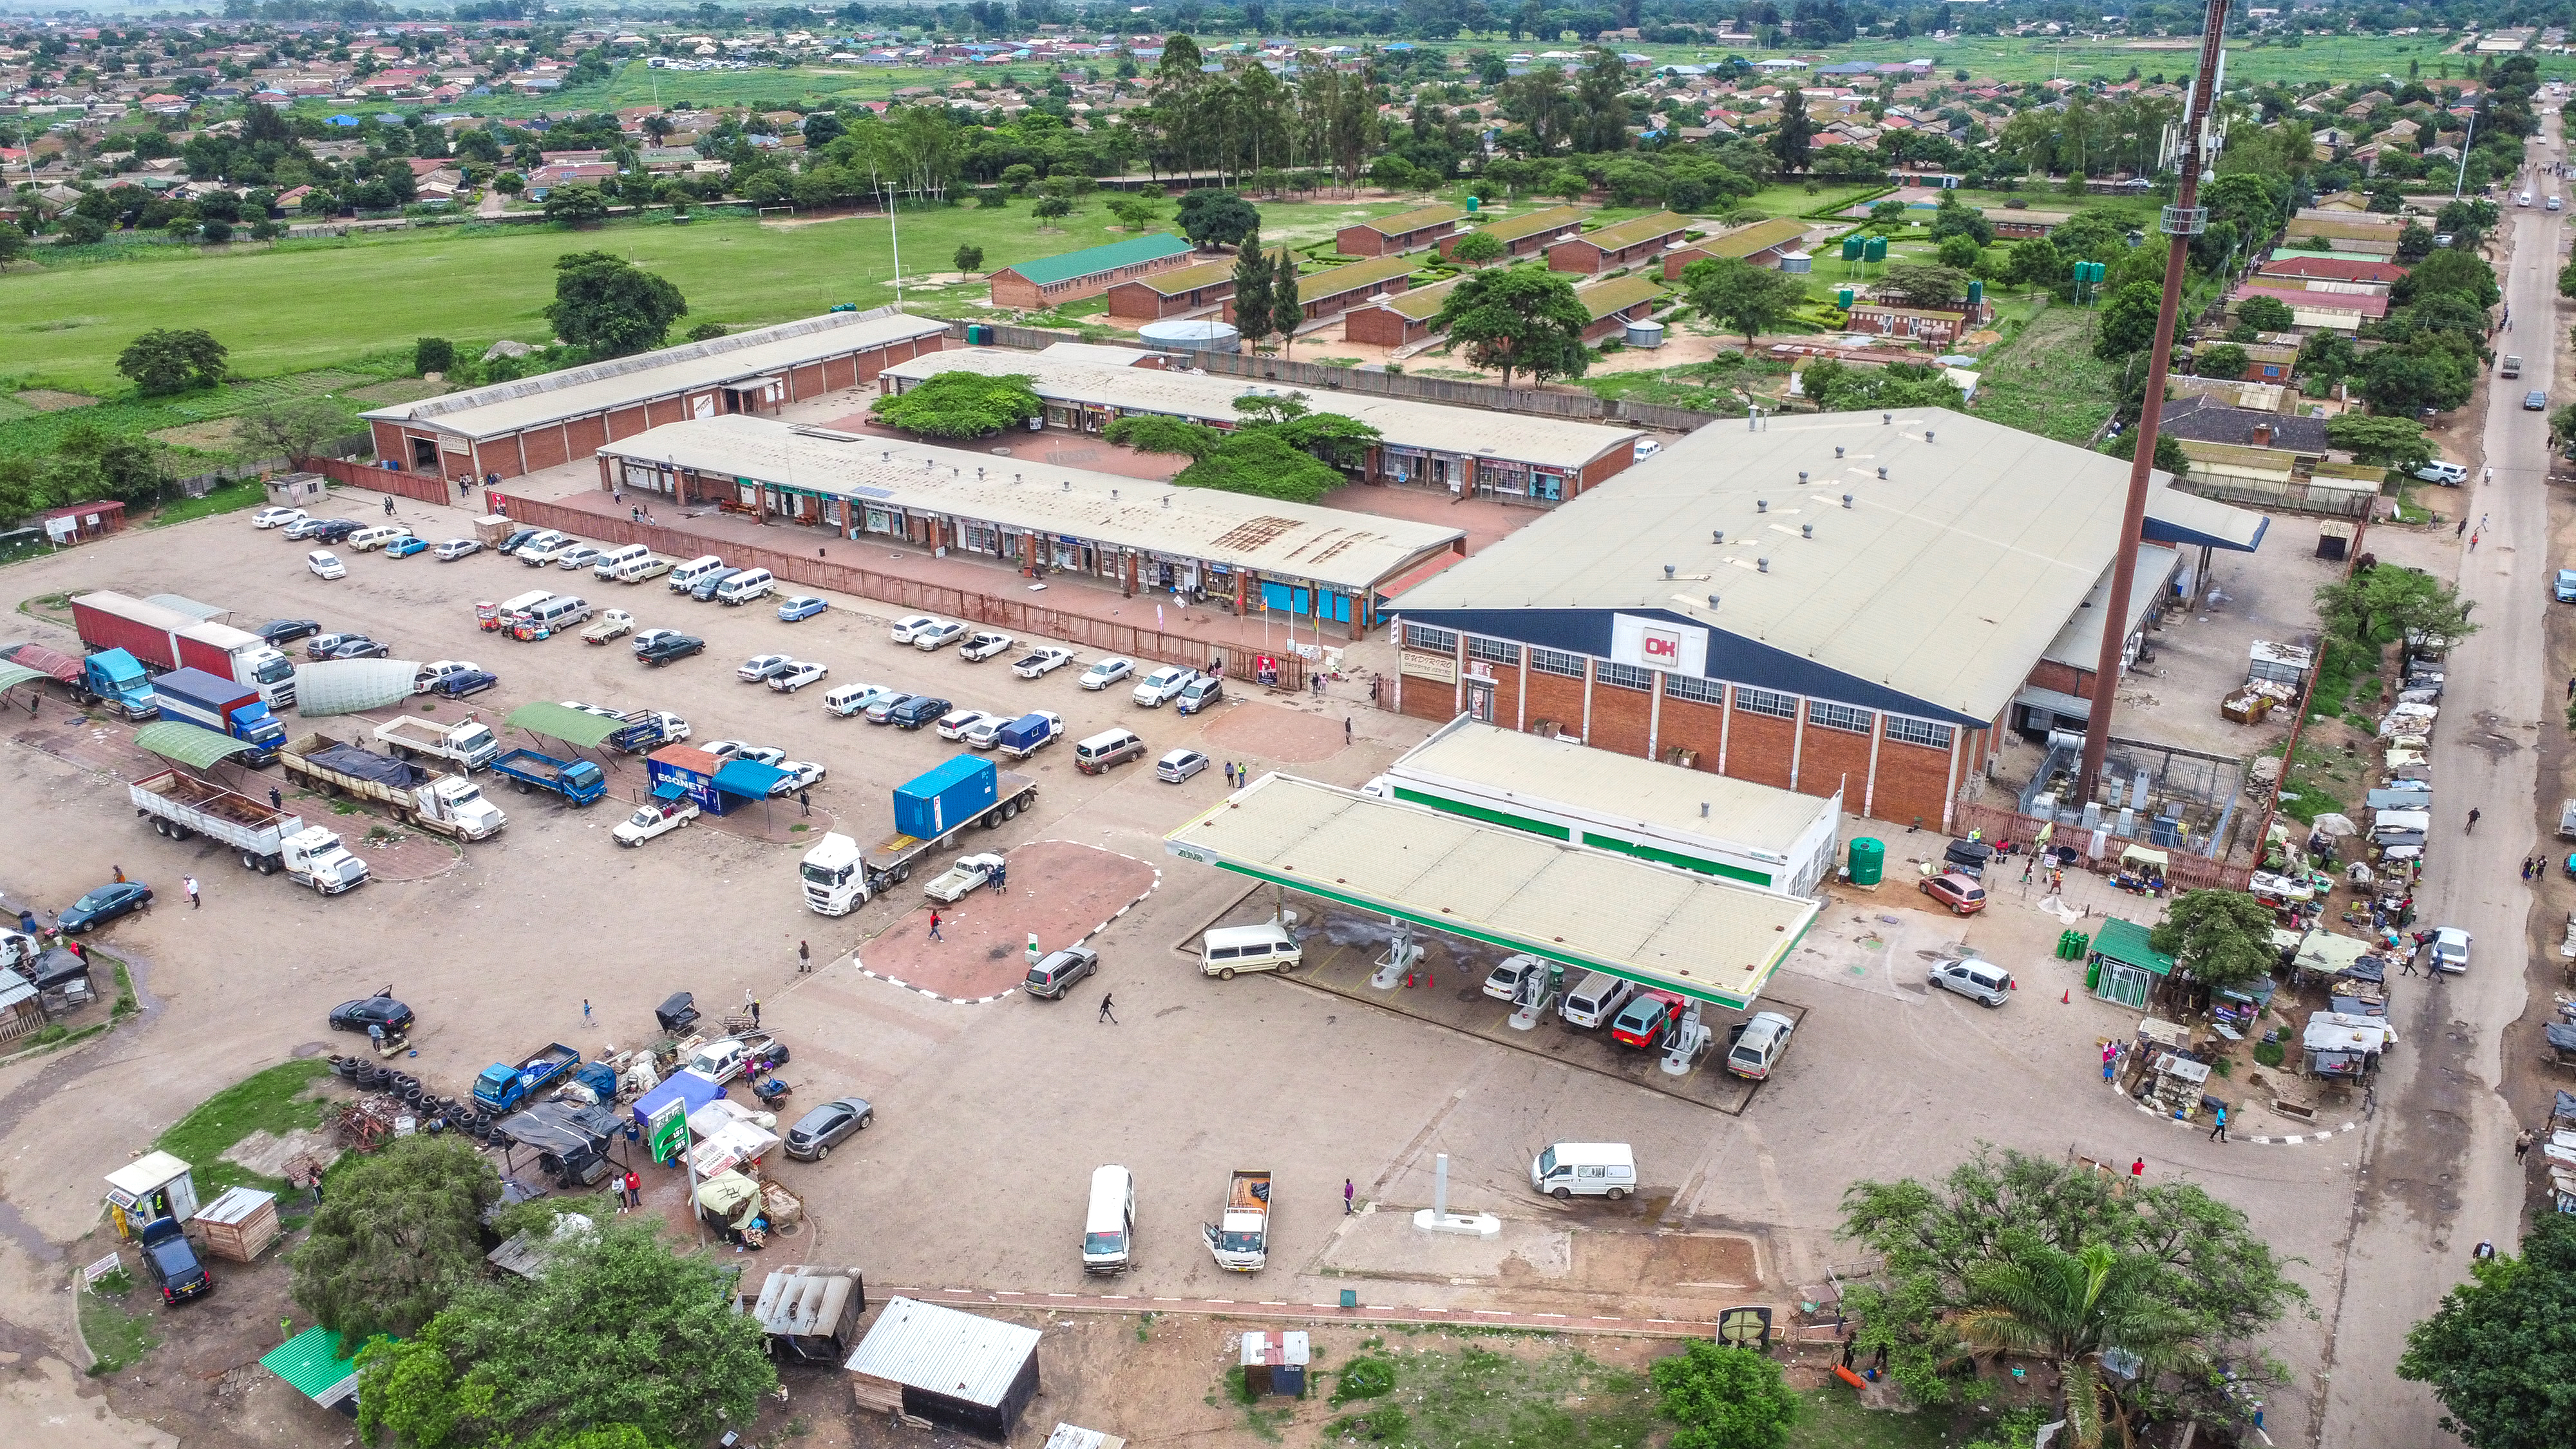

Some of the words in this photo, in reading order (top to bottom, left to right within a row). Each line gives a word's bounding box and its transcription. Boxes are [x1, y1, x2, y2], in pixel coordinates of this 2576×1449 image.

[1645, 637, 1675, 658] OK
[1404, 653, 1452, 668] BUDIRIRO
[658, 772, 704, 792] ECONET
